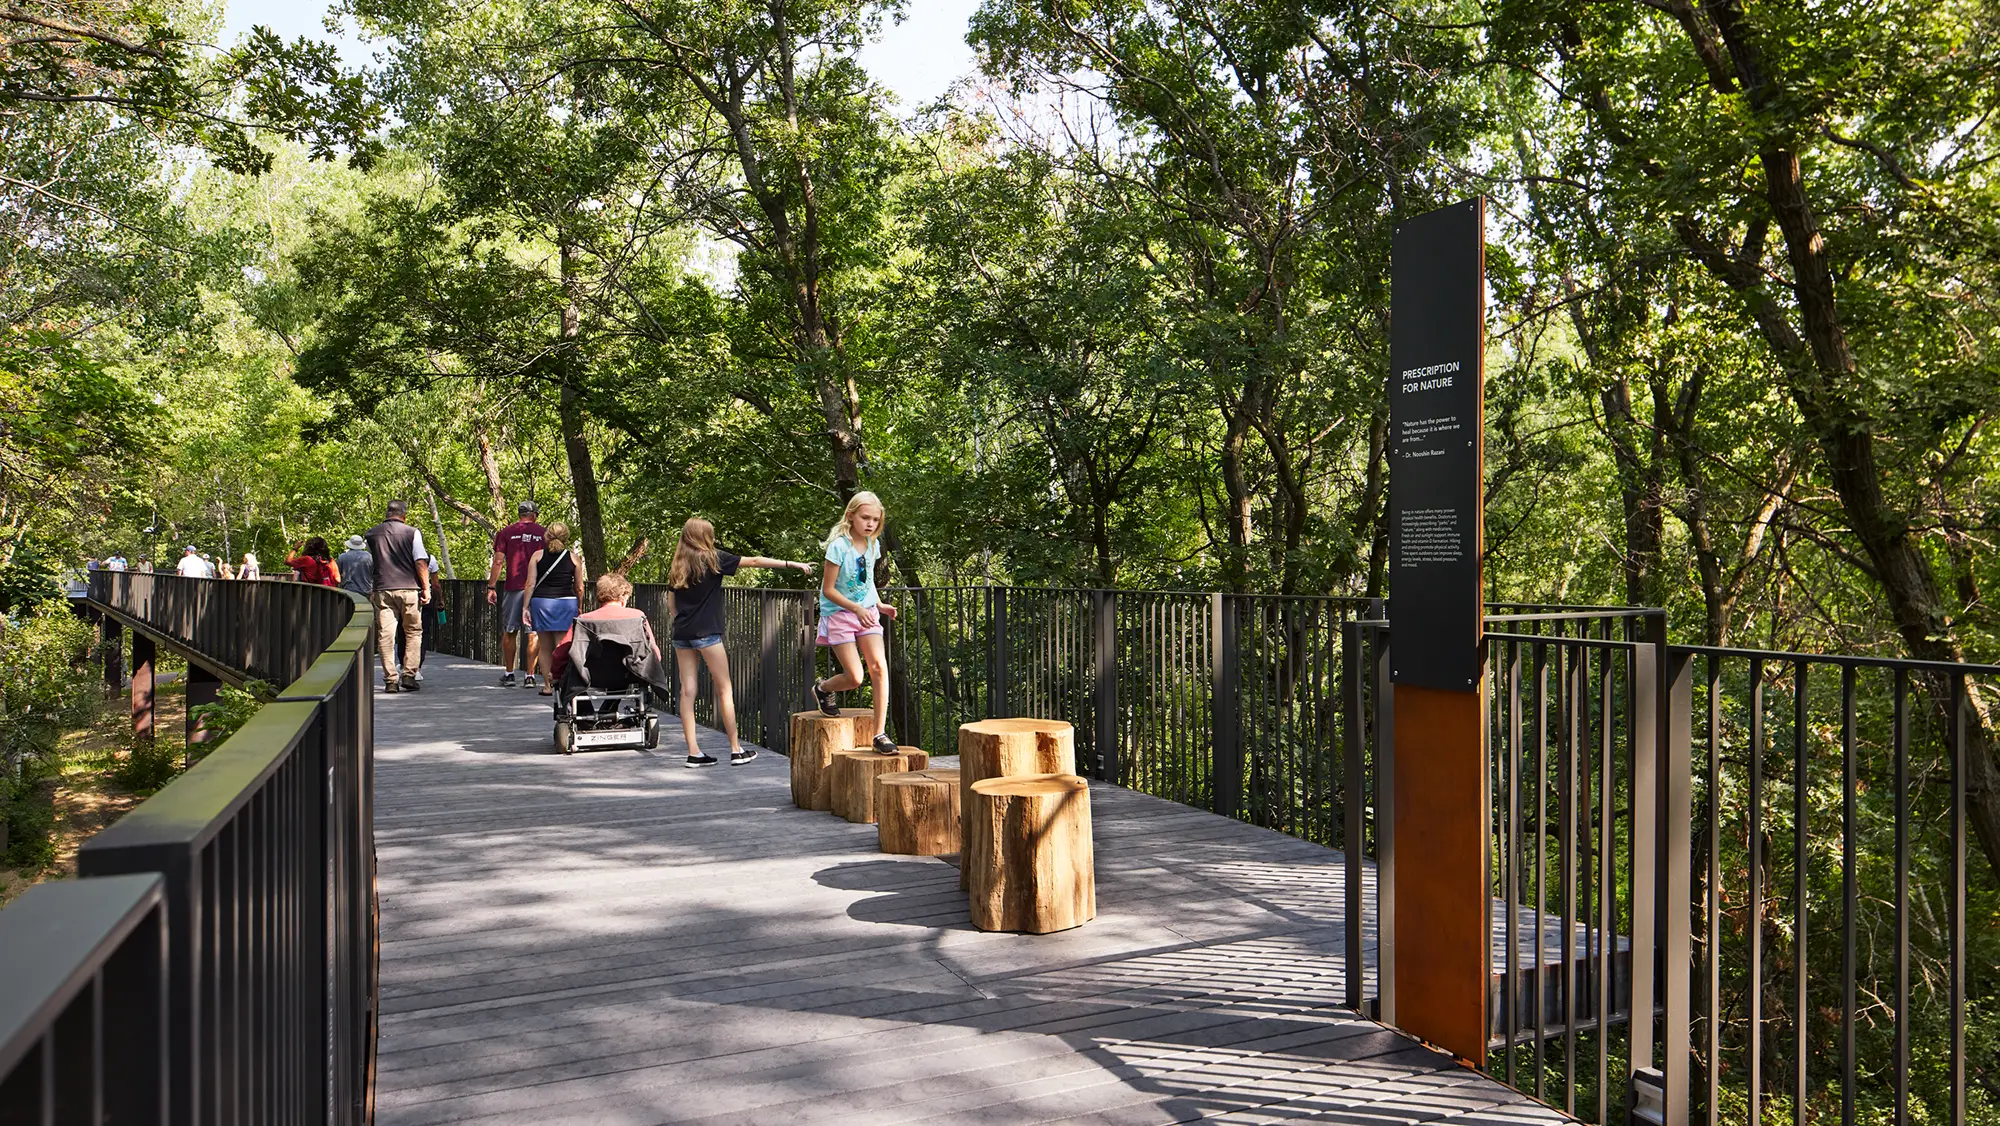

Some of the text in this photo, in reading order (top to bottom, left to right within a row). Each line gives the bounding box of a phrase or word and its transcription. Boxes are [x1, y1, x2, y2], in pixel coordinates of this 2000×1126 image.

[1402, 361, 1460, 380] PRESCRIPTION
[1402, 376, 1453, 394] FOR NATURE
